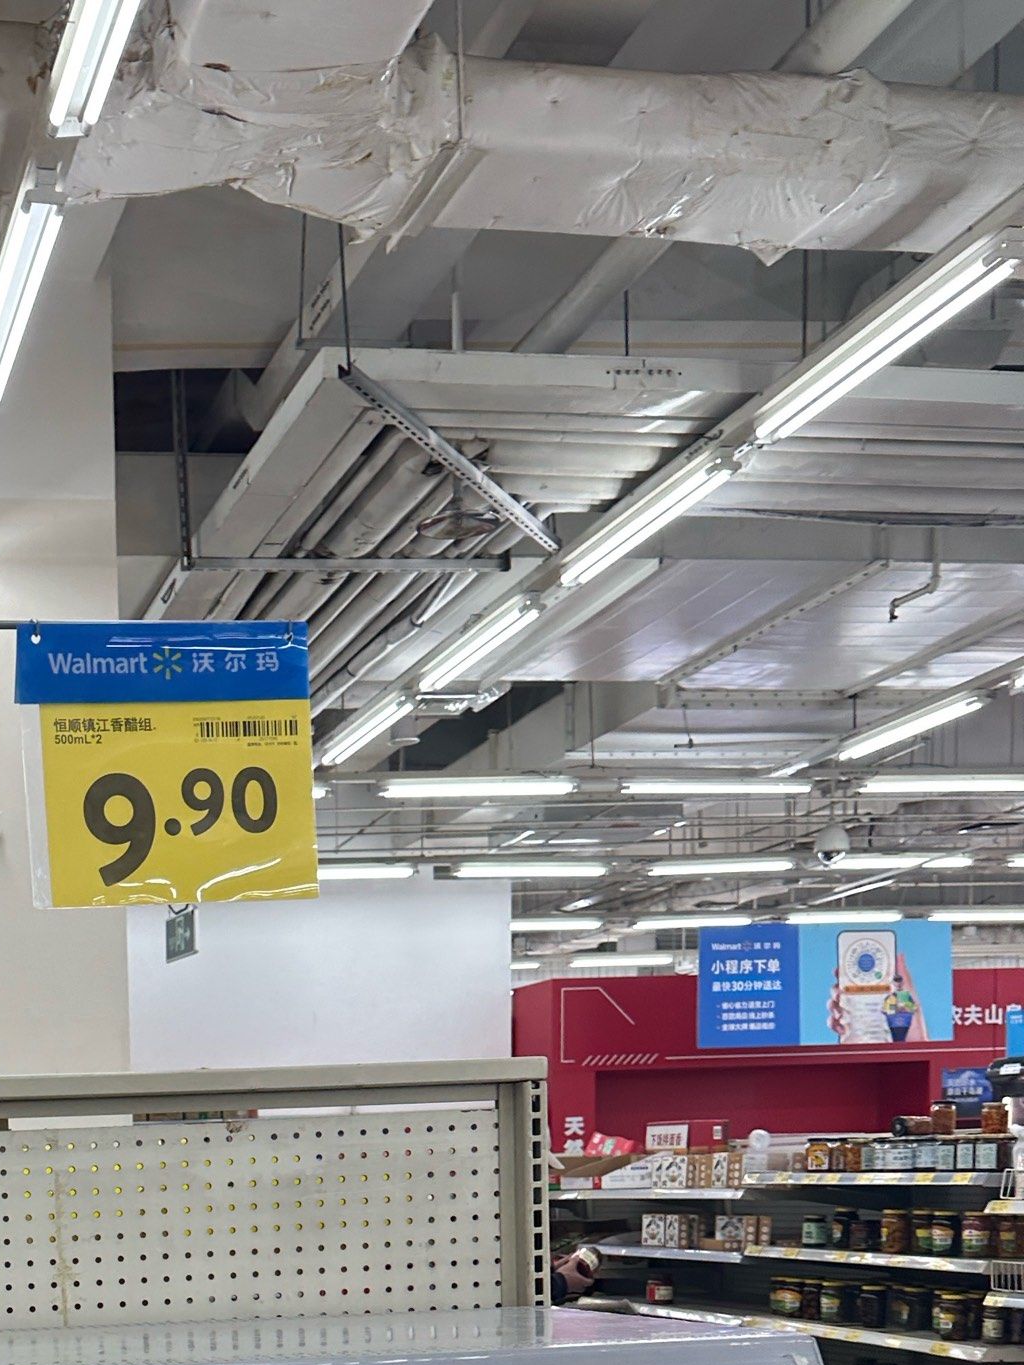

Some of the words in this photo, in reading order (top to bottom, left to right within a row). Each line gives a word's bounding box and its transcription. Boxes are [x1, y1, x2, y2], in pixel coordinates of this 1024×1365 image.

[47, 652, 148, 674] Walmart
[192, 652, 279, 673] 沃尔玛
[83, 766, 278, 888] 9.90
[711, 942, 742, 951] Walmart
[711, 958, 781, 975] 小程序下单
[712, 980, 783, 992] 最快30分钟送达
